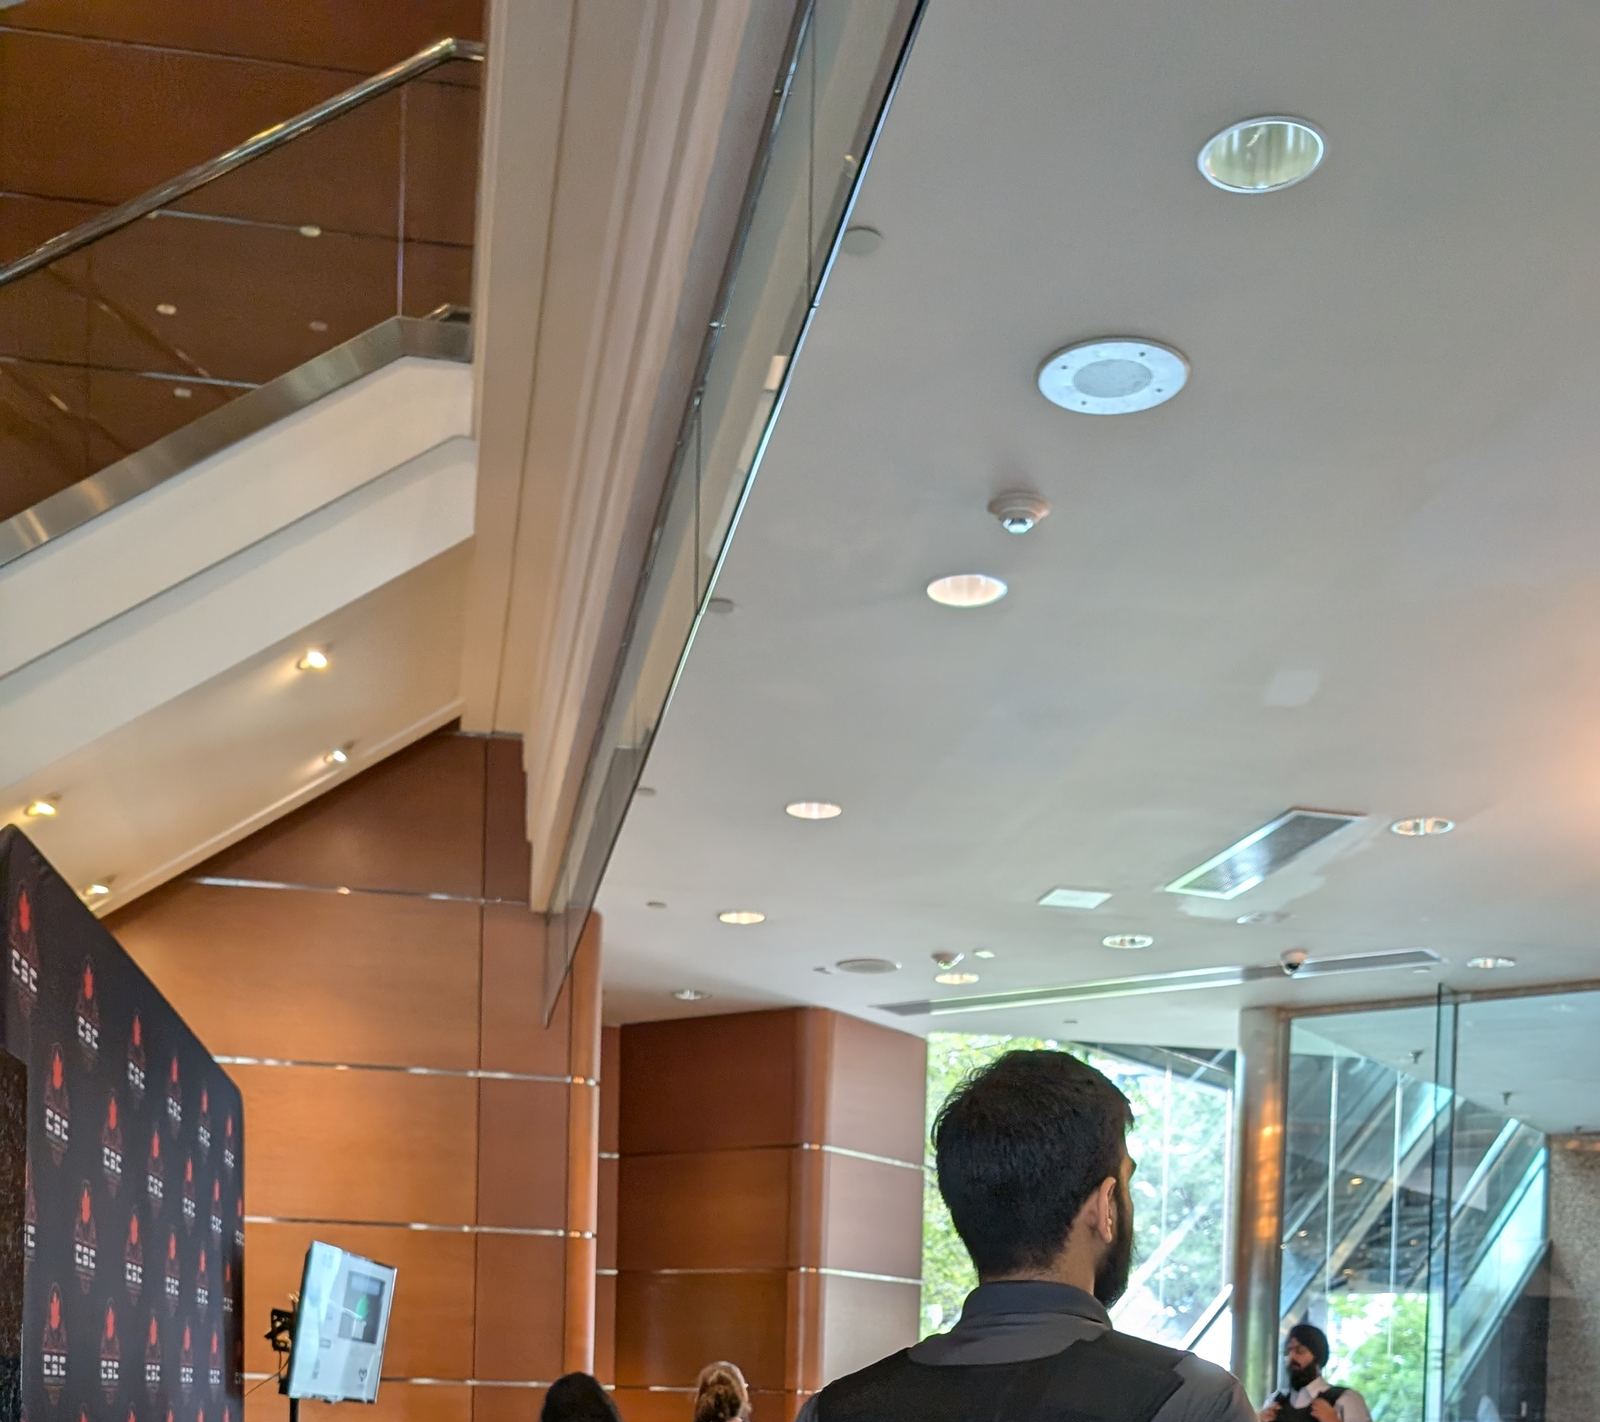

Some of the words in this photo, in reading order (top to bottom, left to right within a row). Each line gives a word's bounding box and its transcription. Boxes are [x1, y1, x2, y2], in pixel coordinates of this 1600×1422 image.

[12, 950, 37, 992] CSC
[78, 1016, 98, 1049] CSC
[129, 1062, 145, 1089] CSC
[46, 1109, 68, 1140] CSC
[104, 1147, 121, 1173] CSC
[76, 1243, 95, 1268] CSC
[126, 1263, 142, 1283] CSC
[44, 1355, 65, 1375] CSC
[101, 1360, 119, 1379] CSC
